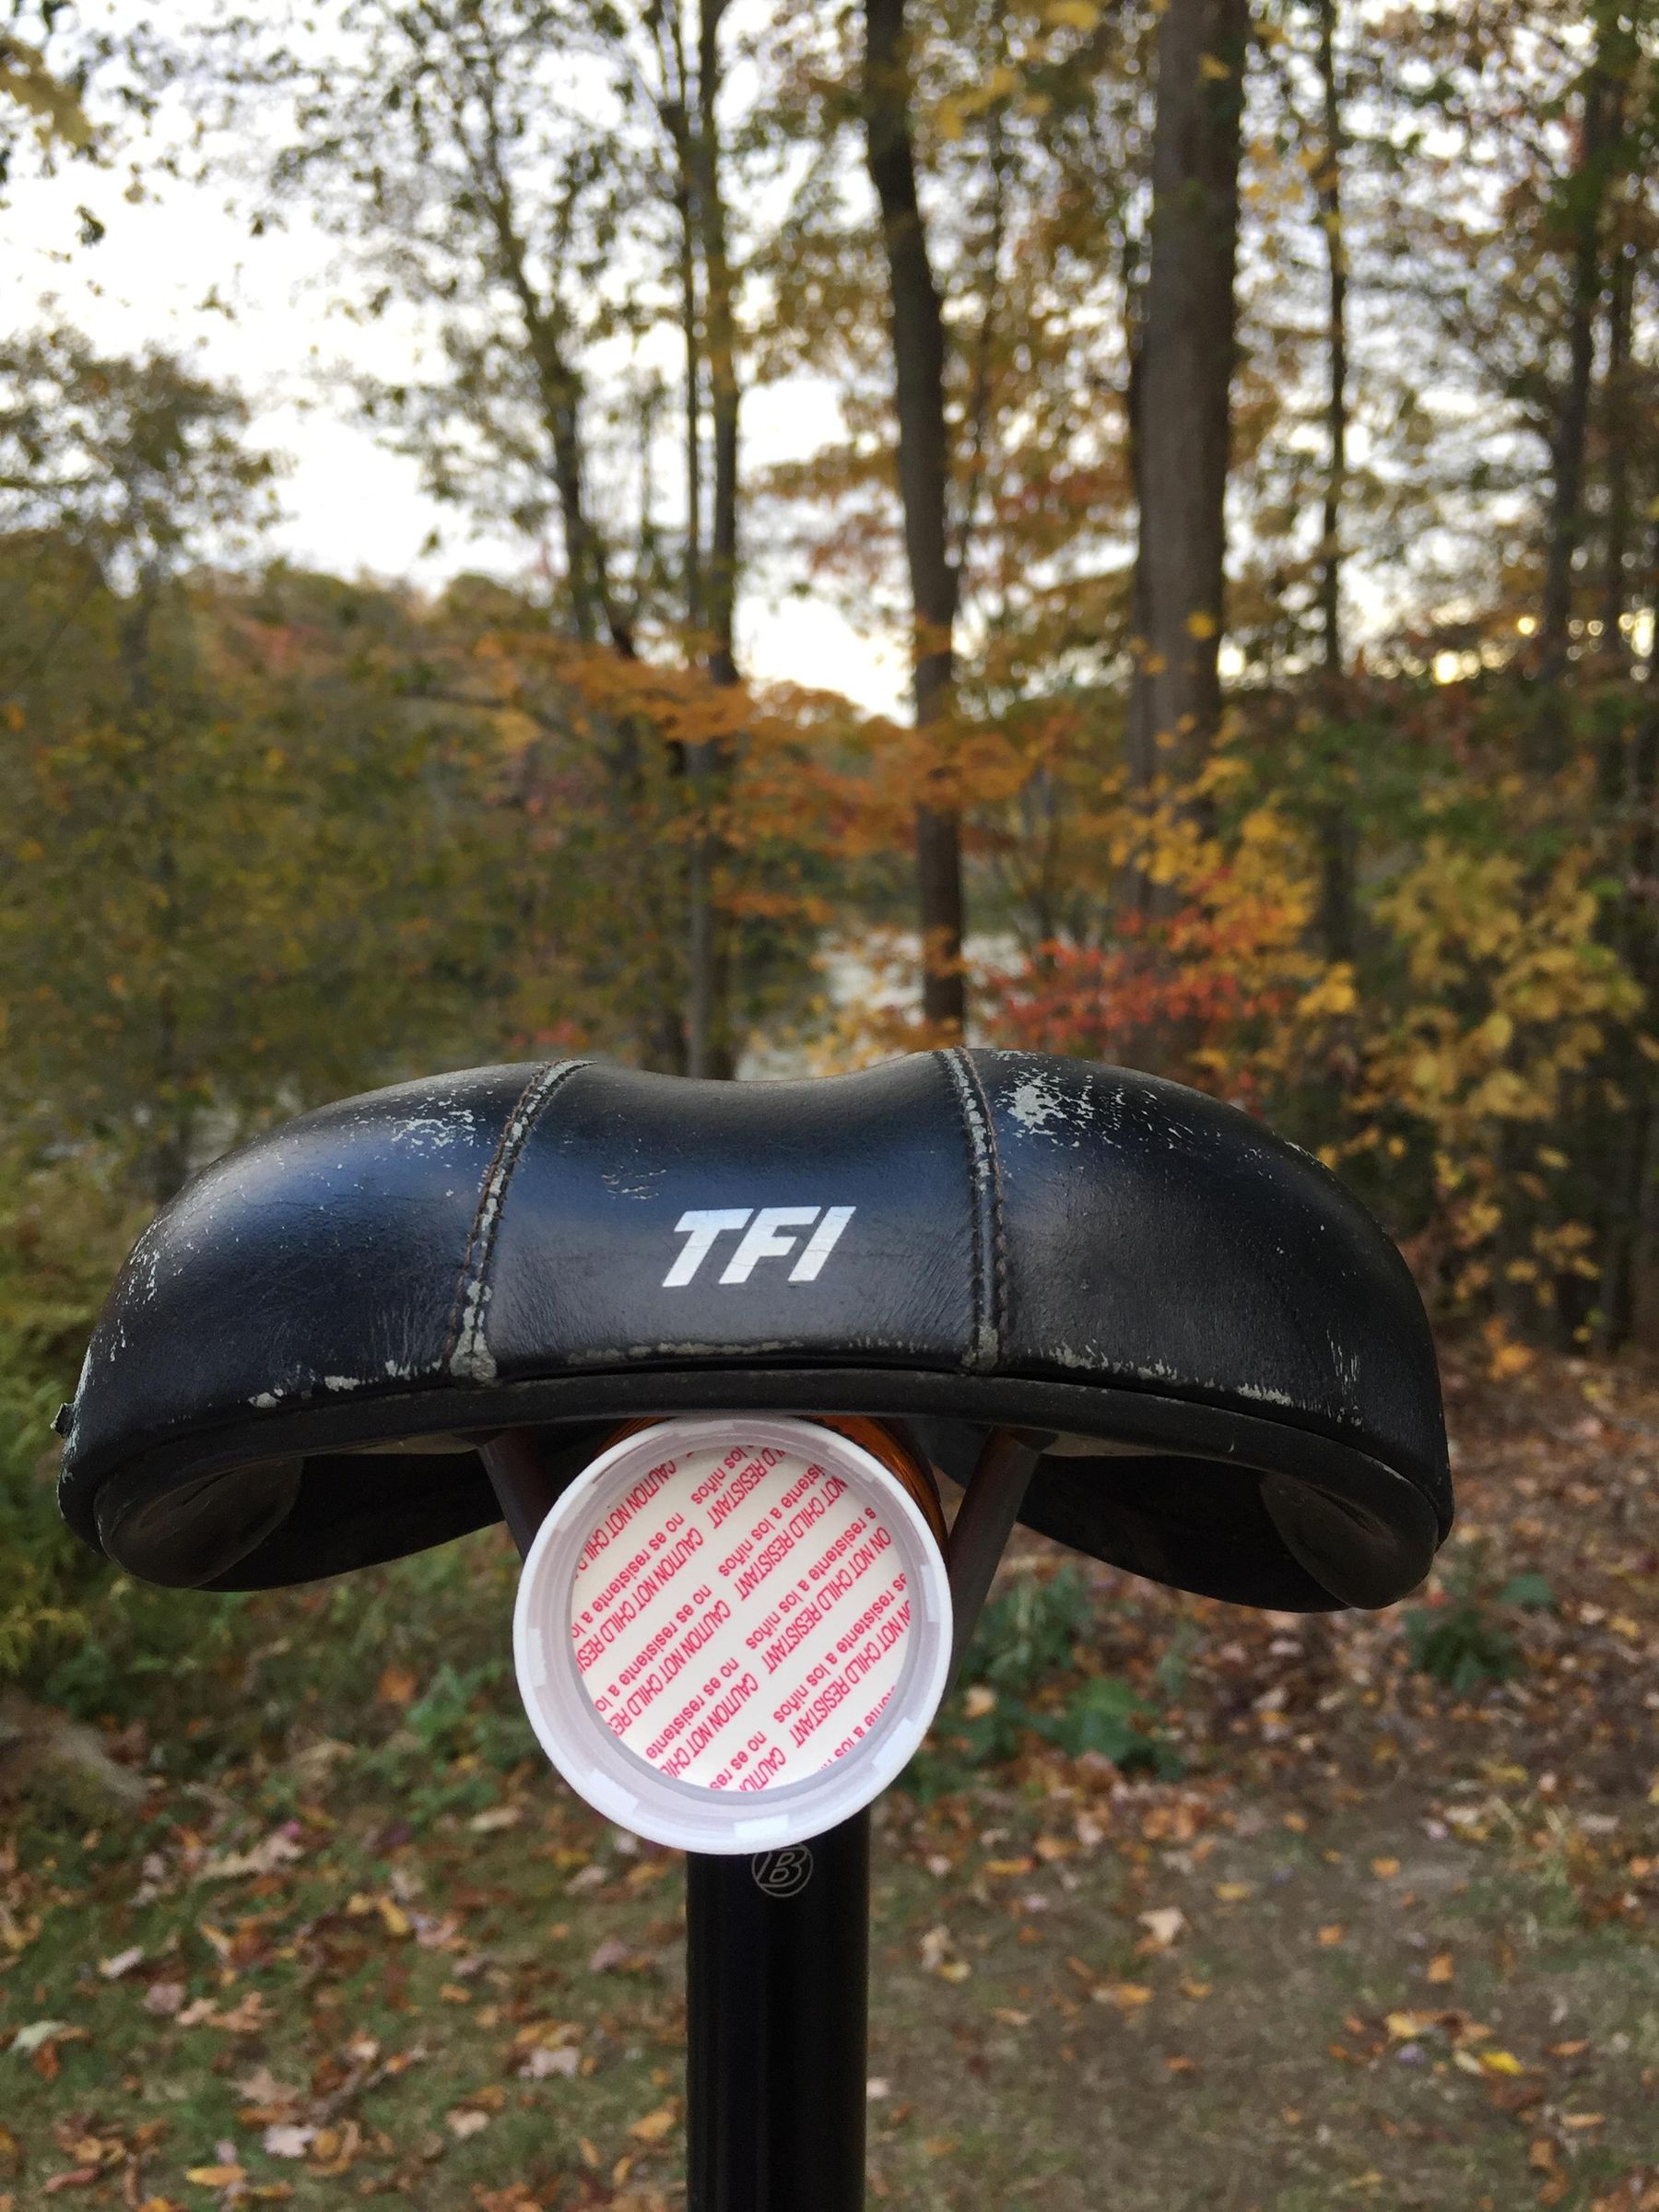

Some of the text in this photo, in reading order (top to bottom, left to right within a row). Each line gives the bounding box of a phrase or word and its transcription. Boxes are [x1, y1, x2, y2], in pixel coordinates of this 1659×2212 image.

[662, 1206, 856, 1287] TFI
[690, 1446, 748, 1505] los niños
[707, 1458, 768, 1530] RESISTANT
[605, 1503, 632, 1539] NOT
[665, 1512, 685, 1533] no
[750, 1518, 775, 1541] los
[770, 1507, 782, 1520] a
[789, 1497, 826, 1539] CHILD
[648, 1532, 667, 1551] es
[653, 1527, 704, 1586] CAUTION
[718, 1539, 754, 1577] niños
[808, 1517, 867, 1581] resistente
[592, 1549, 651, 1613] resistente
[734, 1530, 795, 1601] RESISTANT
[848, 1544, 877, 1579] NOT
[632, 1576, 660, 1611] NOT
[692, 1584, 712, 1605] no
[778, 1591, 803, 1613] los
[797, 1580, 810, 1592] a
[817, 1569, 853, 1611] CHILD
[581, 1611, 594, 1624] a
[600, 1600, 637, 1643] CHILD
[675, 1604, 694, 1624] es
[679, 1599, 731, 1658] CAUTION
[746, 1611, 782, 1650] niños
[836, 1590, 896, 1653] resistente
[618, 1621, 678, 1686] resistente
[761, 1602, 823, 1675] RESISTANT
[877, 1617, 903, 1653] NOT
[659, 1648, 687, 1684] NOT
[806, 1664, 831, 1687] los
[825, 1652, 838, 1665] a
[844, 1641, 882, 1685] CHILD
[607, 1684, 620, 1697] a
[626, 1673, 664, 1716] CHILD
[645, 1658, 739, 1759] no es resistente
[707, 1673, 759, 1732] CAUTION
[772, 1685, 809, 1724] niños
[789, 1676, 852, 1748] RESISTANT
[686, 1723, 714, 1758] NOT
[747, 1731, 767, 1752] no
[730, 1750, 749, 1771] es
[739, 1747, 786, 1792] CAUTIO
